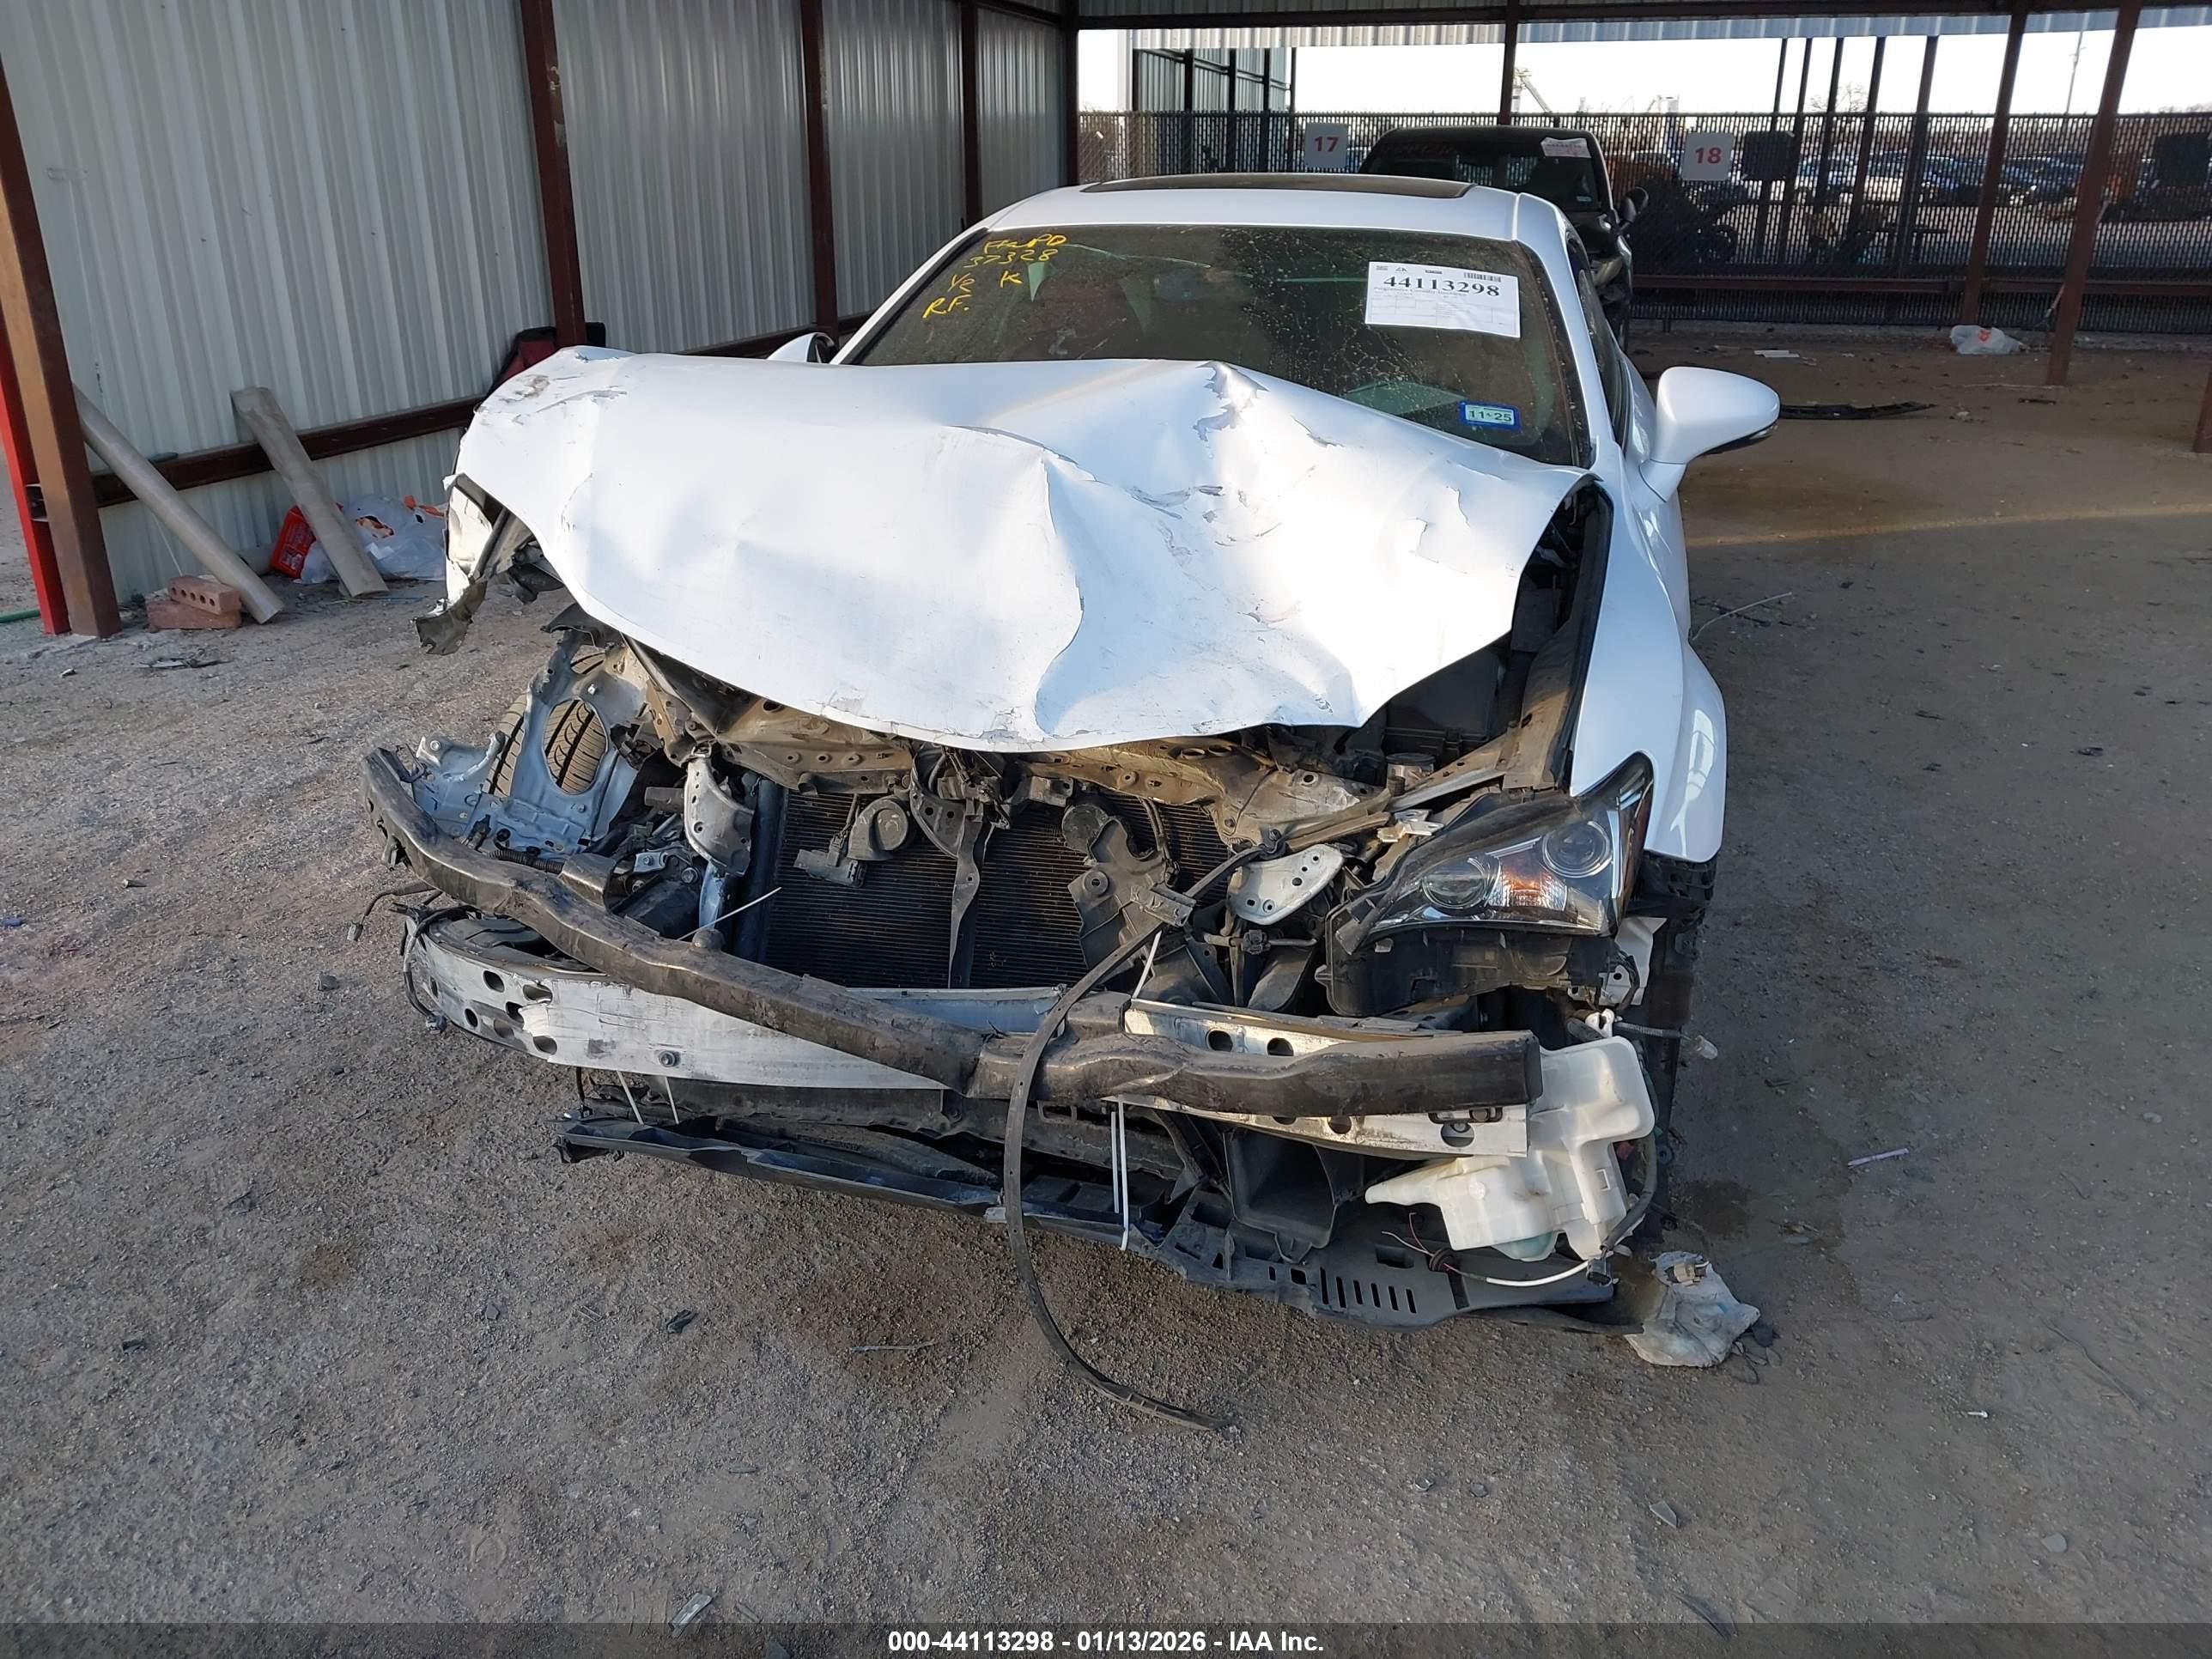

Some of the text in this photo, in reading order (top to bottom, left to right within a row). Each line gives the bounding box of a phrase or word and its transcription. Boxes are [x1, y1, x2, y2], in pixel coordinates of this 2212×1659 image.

[1314, 136, 1340, 152] 17
[1695, 147, 1722, 164] 18
[1383, 275, 1500, 297] 44113298
